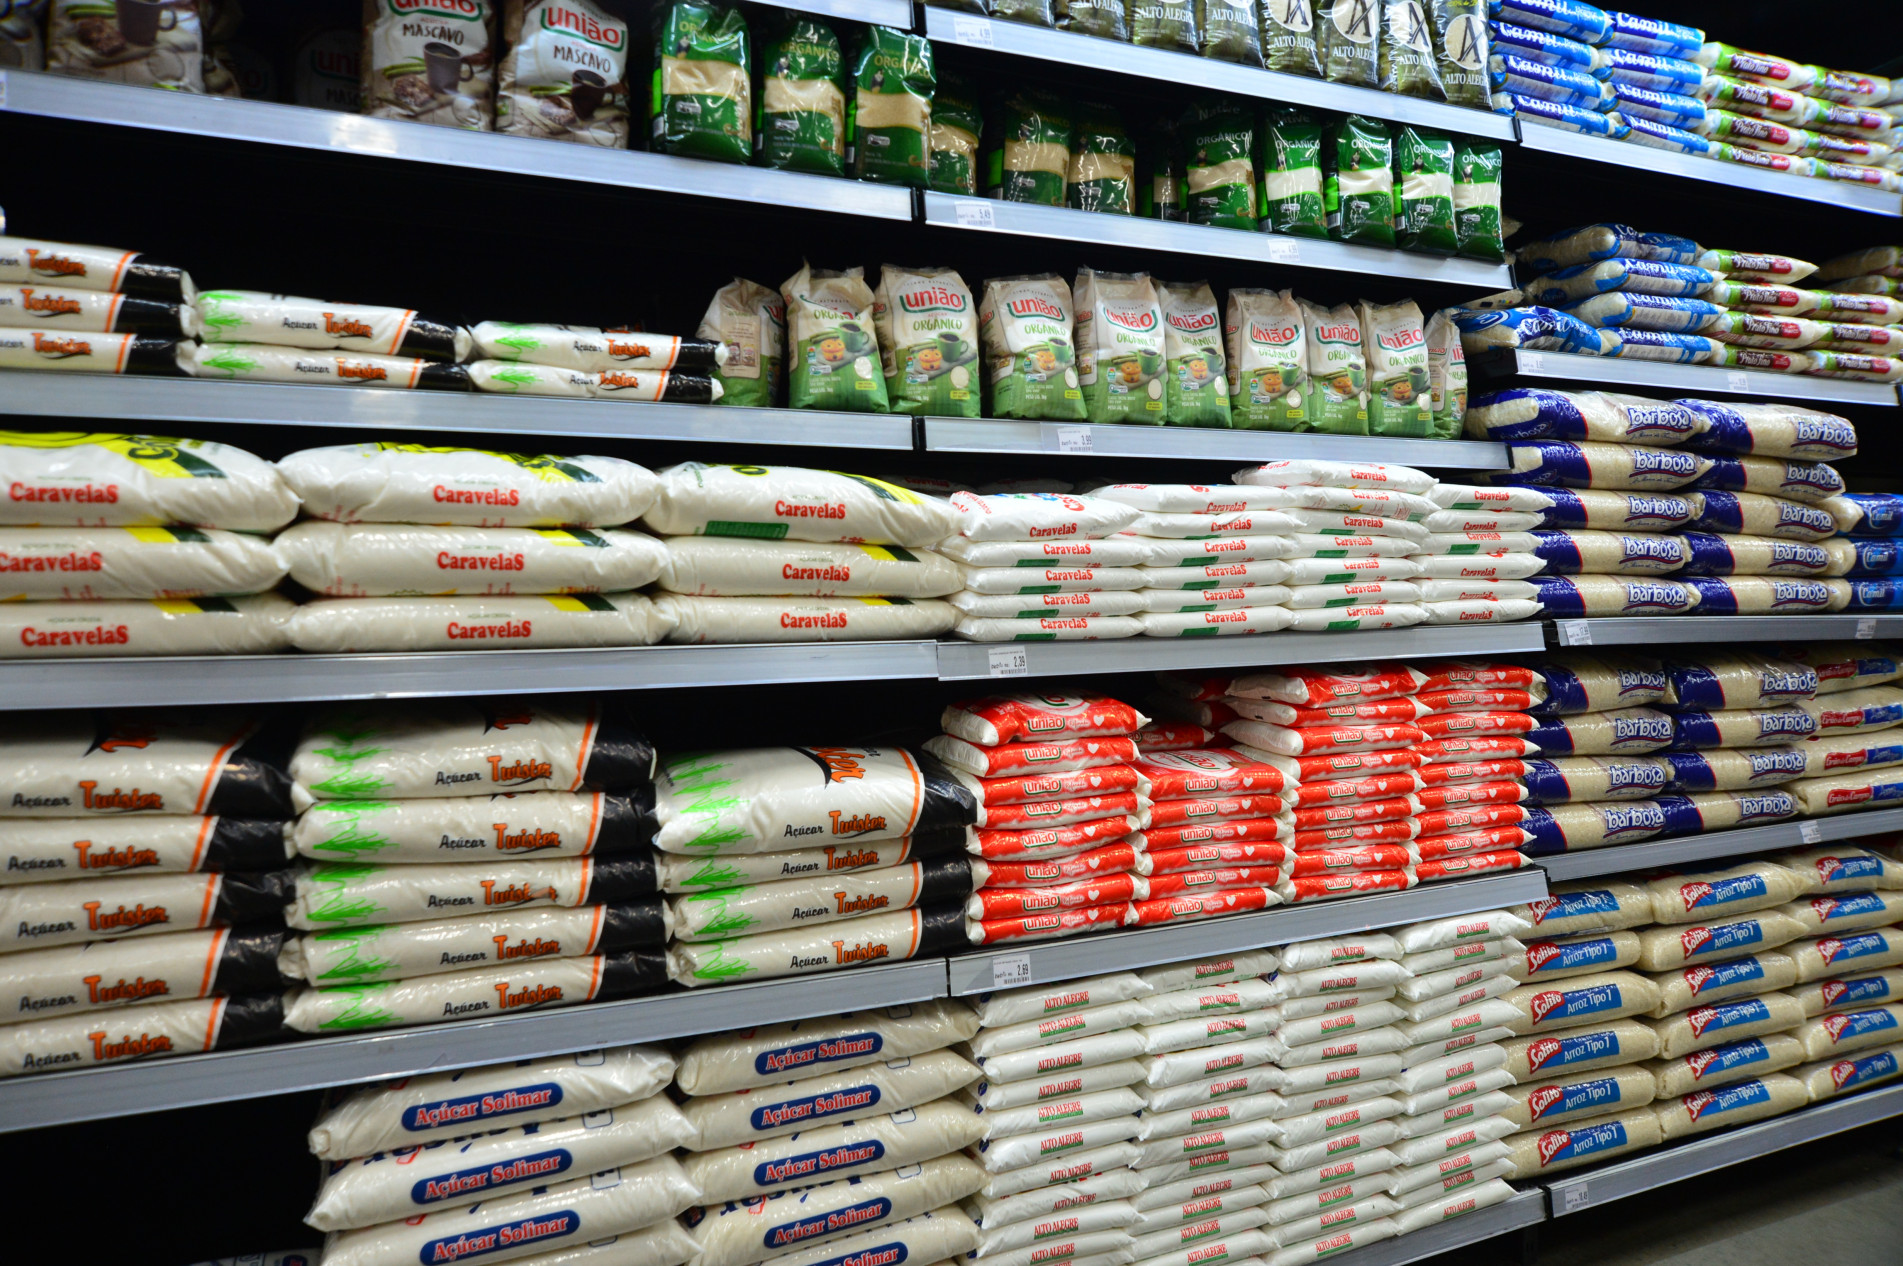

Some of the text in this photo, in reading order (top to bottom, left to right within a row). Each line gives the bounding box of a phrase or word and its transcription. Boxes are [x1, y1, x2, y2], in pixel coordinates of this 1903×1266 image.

[1139, 7, 1164, 19] ALTO
[403, 24, 464, 46] MASCAVO
[548, 7, 620, 44] união
[1498, 23, 1560, 47] Camil
[1616, 12, 1672, 37] Camil
[554, 46, 611, 72] MASCAVO
[1508, 55, 1566, 81] Camil
[1613, 48, 1668, 72] Camil
[905, 287, 961, 309] união
[1013, 297, 1061, 317] união
[1107, 308, 1151, 328] união
[1169, 313, 1214, 329] união
[1513, 316, 1570, 337] Camil
[1253, 325, 1294, 343] união
[1320, 326, 1359, 342] união
[1380, 327, 1423, 349] união
[1628, 408, 1692, 427] barbosa
[1798, 423, 1857, 446] barbosa
[1635, 450, 1696, 472] barbosa
[1629, 496, 1688, 517] barbosa
[1782, 503, 1833, 528] barbosa
[1868, 505, 1894, 529] Camil
[1863, 545, 1889, 570] Camil
[1629, 583, 1688, 603] barbosa
[1776, 583, 1829, 600] barbosa
[1859, 581, 1885, 605] Camil
[1030, 718, 1064, 730] união
[1616, 719, 1672, 739] barbosa
[1762, 712, 1815, 733] barbosa
[1335, 731, 1362, 742] união
[435, 755, 551, 785] Açúcar Twister
[1333, 757, 1359, 767] união
[1753, 751, 1805, 772] barbosa
[1187, 779, 1216, 789] união
[1611, 765, 1665, 785] barbosa
[79, 780, 164, 810] Twister
[1026, 780, 1060, 793] união
[1187, 803, 1216, 814] união
[1741, 796, 1792, 818] barbosa
[784, 811, 887, 837] Açúcar Twister
[1607, 809, 1664, 830] barbosa
[439, 823, 561, 850] Açúcar Twister
[1183, 829, 1211, 839] união
[1447, 839, 1470, 849] união
[781, 847, 879, 875] Açúcar Twister
[1027, 866, 1060, 877] união
[83, 902, 169, 931] Twister
[792, 892, 889, 919] Açúcar Twister
[1173, 901, 1201, 913] união
[1457, 921, 1489, 934] ALTO ALEGRE
[1715, 935, 1733, 948] Arroz
[1733, 927, 1748, 942] Tipo
[440, 935, 561, 965] Açúcar Twister
[1685, 928, 1709, 957] Solito
[791, 940, 889, 968] Açúcar Twister
[1044, 991, 1089, 1009] ALTO ALEGRE
[1533, 994, 1561, 1023] Solito
[1567, 1002, 1587, 1014] Arroz
[1588, 994, 1605, 1006] Tipo
[89, 1031, 173, 1060] Twister
[765, 1039, 874, 1070] Açúcar Solimar
[1530, 1040, 1558, 1071] Solito
[1564, 1048, 1585, 1062] Arroz
[1586, 1039, 1604, 1053] Tipo
[1038, 1053, 1082, 1071] ALTO ALEGRE
[1206, 1054, 1244, 1071] ALTO ALEGRE
[1326, 1067, 1360, 1082] ALTO ALEGRE
[1833, 1063, 1854, 1087] Solito
[415, 1088, 552, 1126] Açúcar Solimar
[762, 1089, 872, 1125] Açúcar Solimar
[1532, 1089, 1559, 1120] Solito
[1566, 1095, 1586, 1110] Arroz
[1587, 1087, 1605, 1102] Tipo
[1041, 1132, 1083, 1152] ALTO ALEGRE
[1542, 1134, 1567, 1164] Solito
[1574, 1141, 1594, 1155] Arroz
[1594, 1131, 1611, 1145] Tipo
[765, 1144, 875, 1181] Açúcar Solimar
[425, 1155, 561, 1198] Açúcar Solimar
[1320, 1208, 1355, 1225] ALTO ALEGRE
[1444, 1199, 1475, 1215] ALTO ALEGRE
[774, 1204, 883, 1243] Açúcar Solimar
[433, 1216, 568, 1261] Açúcar Solimar
